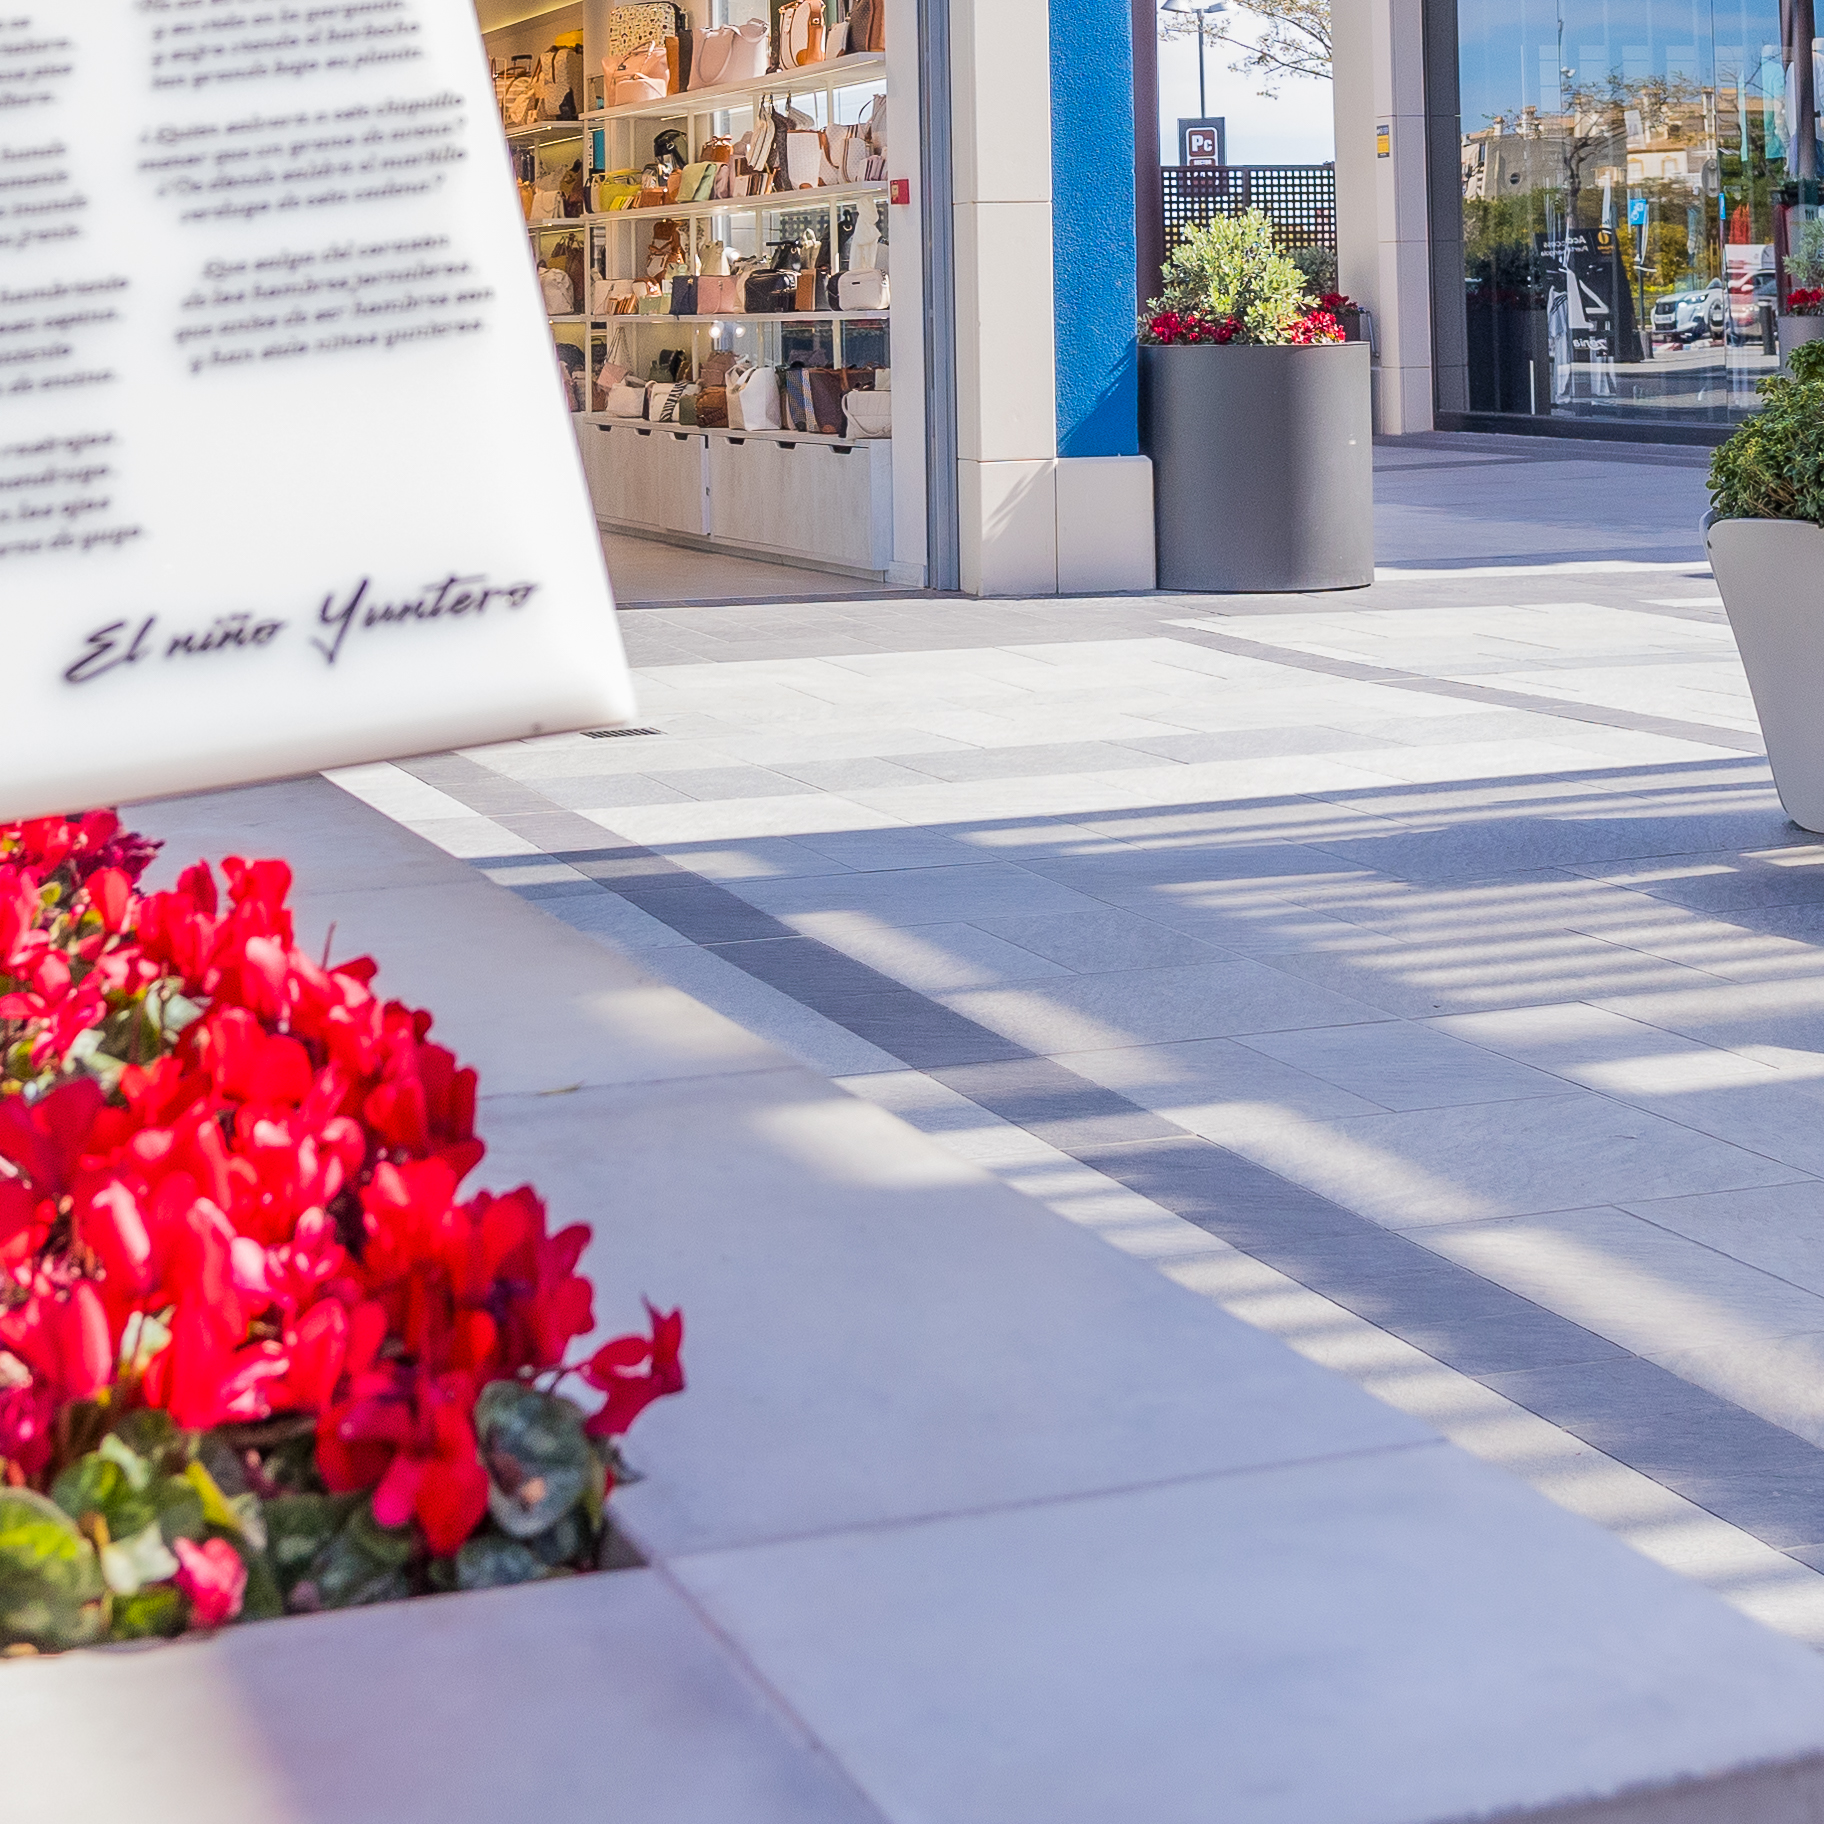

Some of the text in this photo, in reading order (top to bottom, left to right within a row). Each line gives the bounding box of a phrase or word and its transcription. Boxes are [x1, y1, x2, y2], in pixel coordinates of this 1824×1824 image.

[1191, 134, 1213, 152] Pc
[63, 615, 156, 684] El
[164, 612, 285, 659] niño
